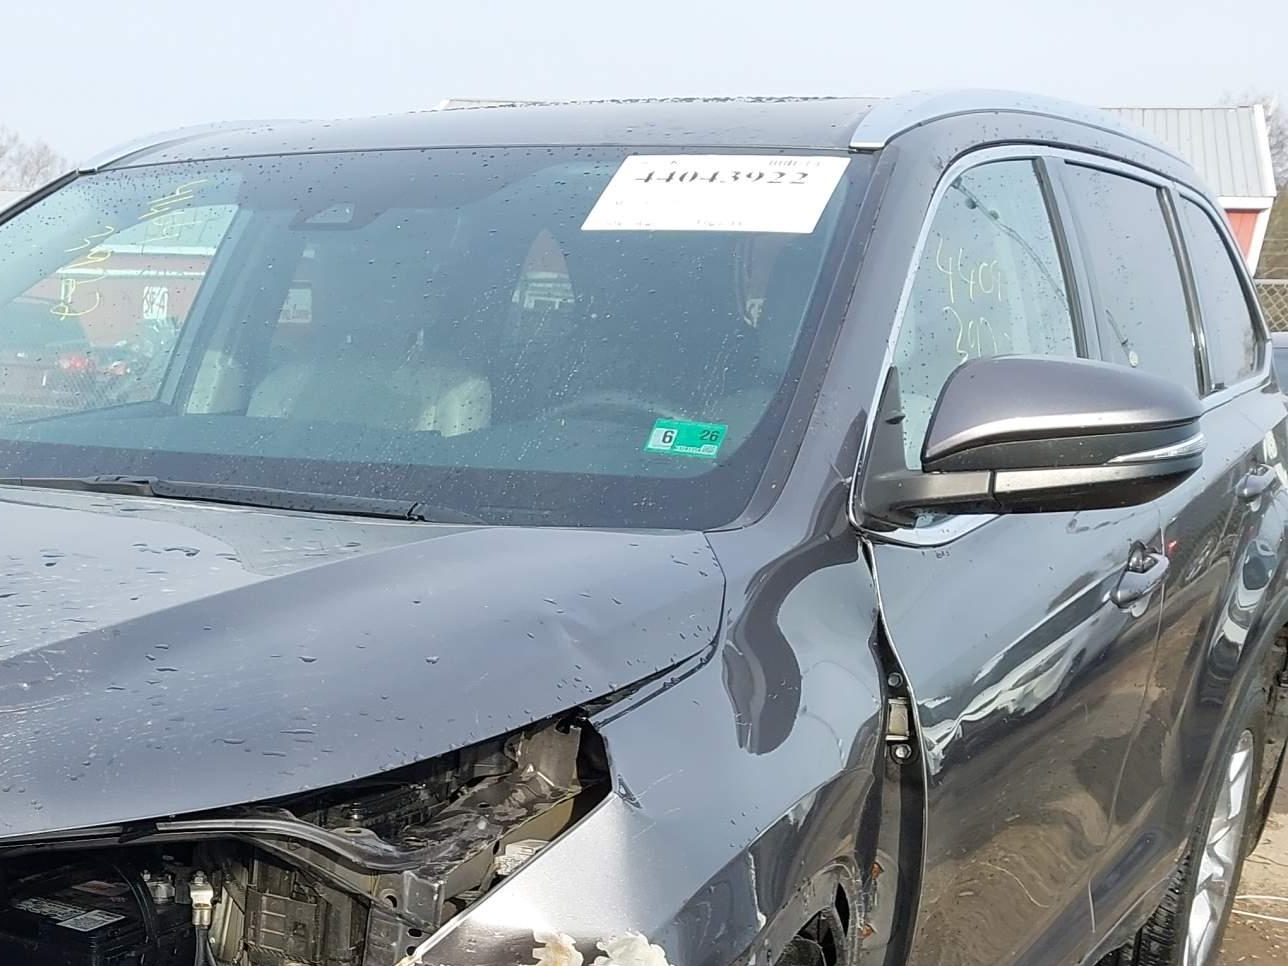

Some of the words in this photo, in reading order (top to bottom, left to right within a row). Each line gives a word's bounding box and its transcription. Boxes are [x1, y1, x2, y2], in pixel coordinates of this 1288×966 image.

[634, 170, 809, 185] 44043922
[662, 430, 675, 444] 6
[700, 429, 720, 442] 26
